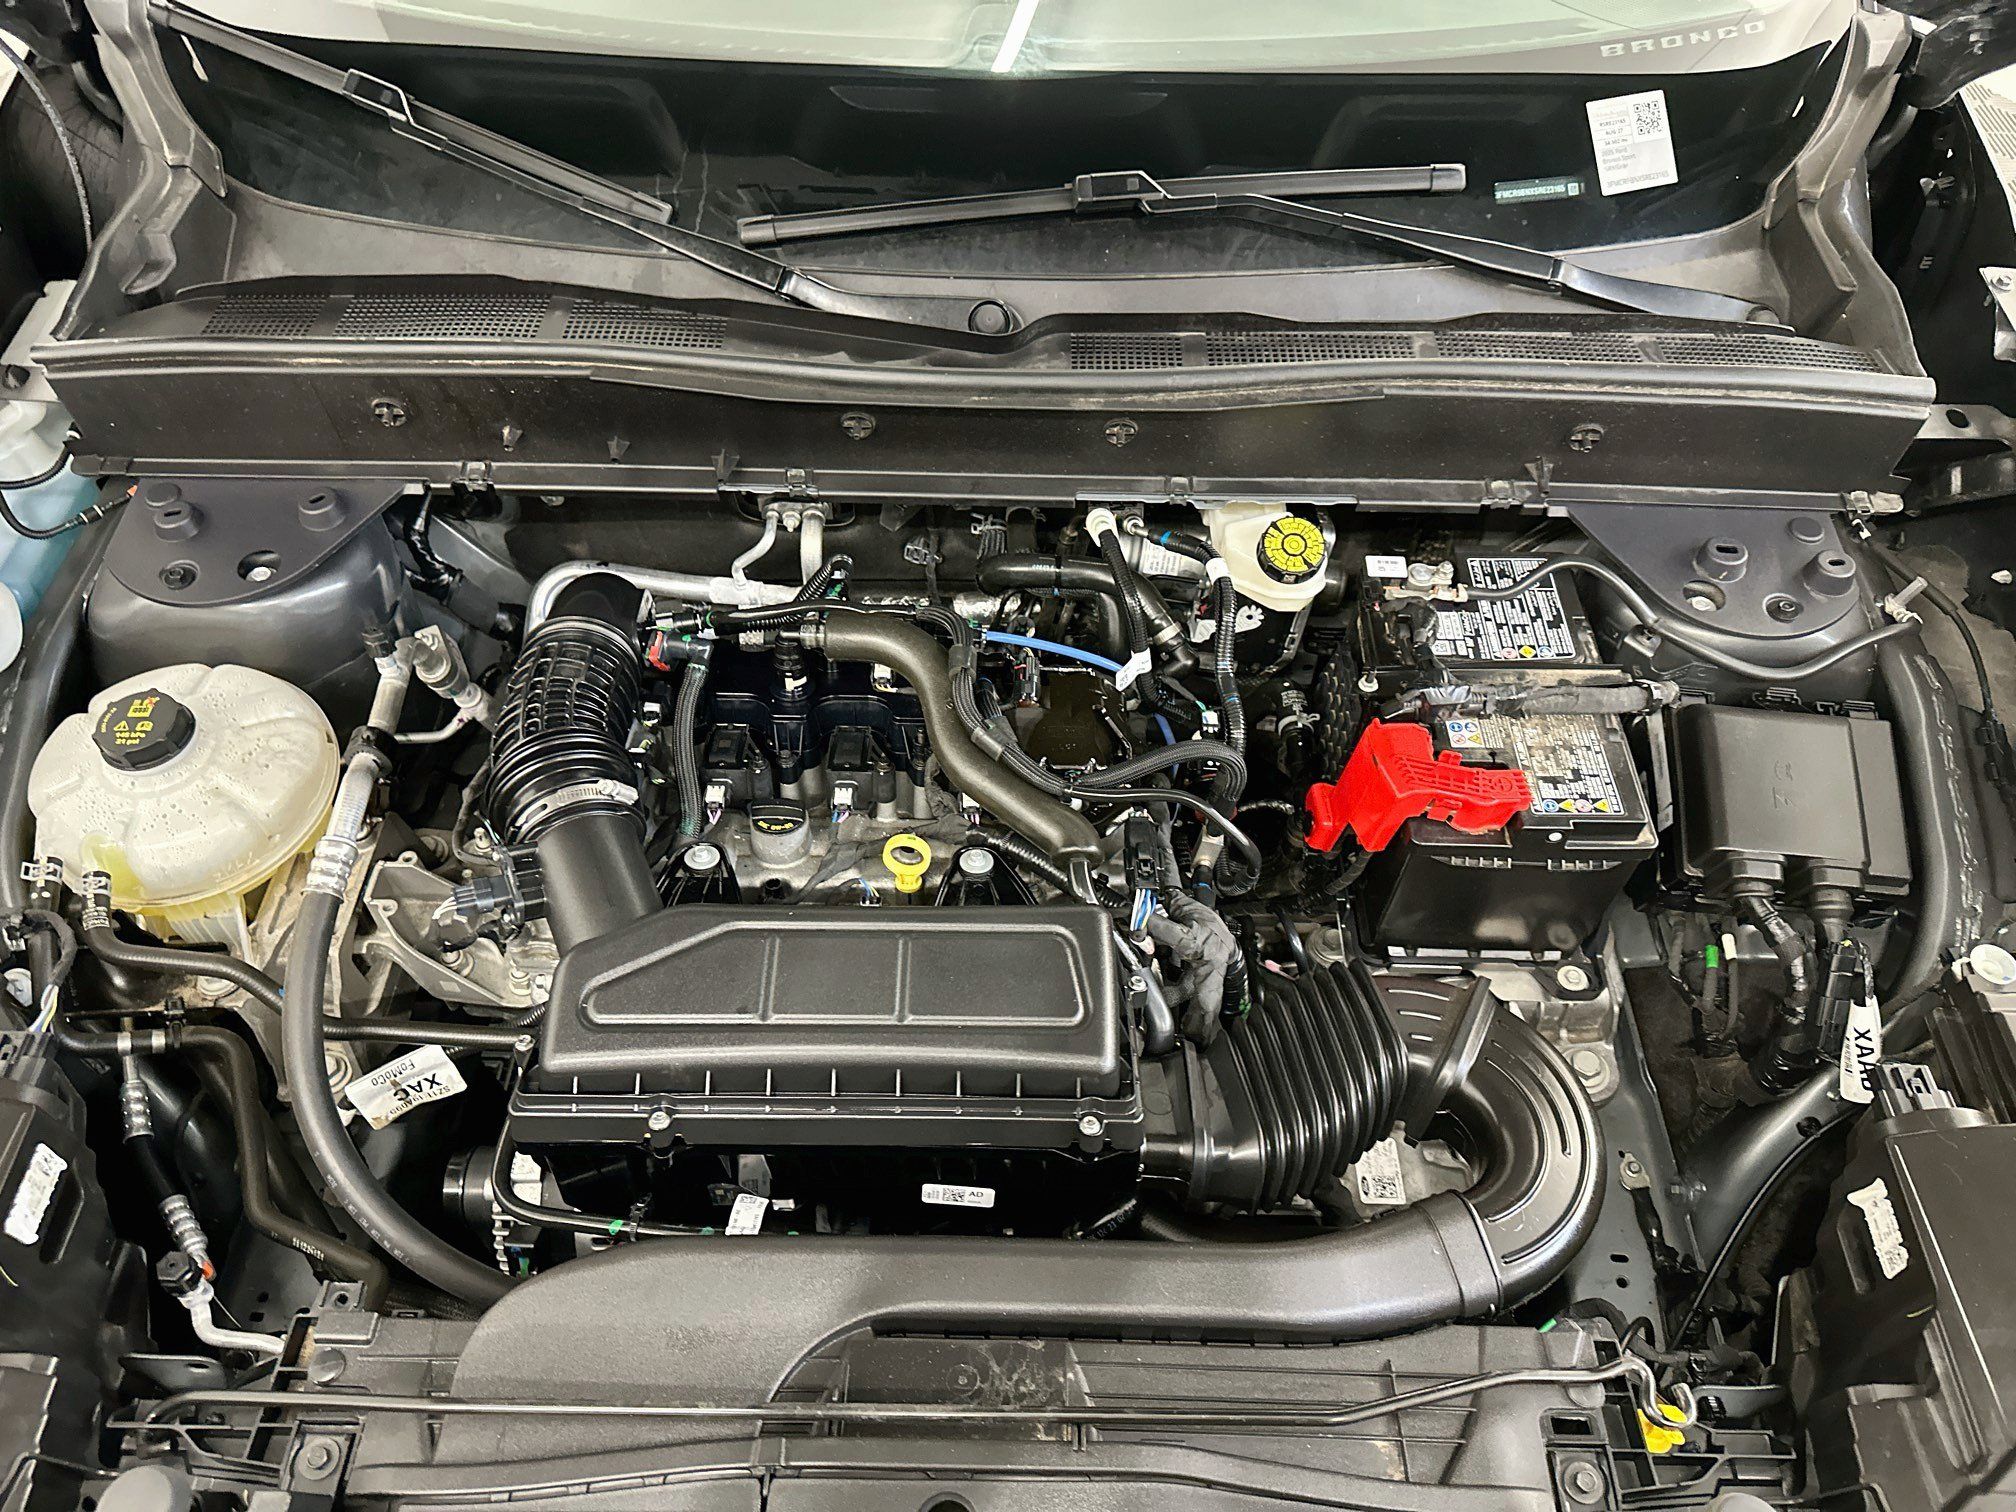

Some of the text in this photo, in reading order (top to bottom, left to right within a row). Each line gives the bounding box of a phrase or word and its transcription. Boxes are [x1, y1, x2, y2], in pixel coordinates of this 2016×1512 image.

[1600, 20, 1766, 57] BRONCO
[371, 1059, 416, 1087] FoMoCo
[393, 1072, 443, 1102] XAC
[968, 1191, 984, 1199] AD
